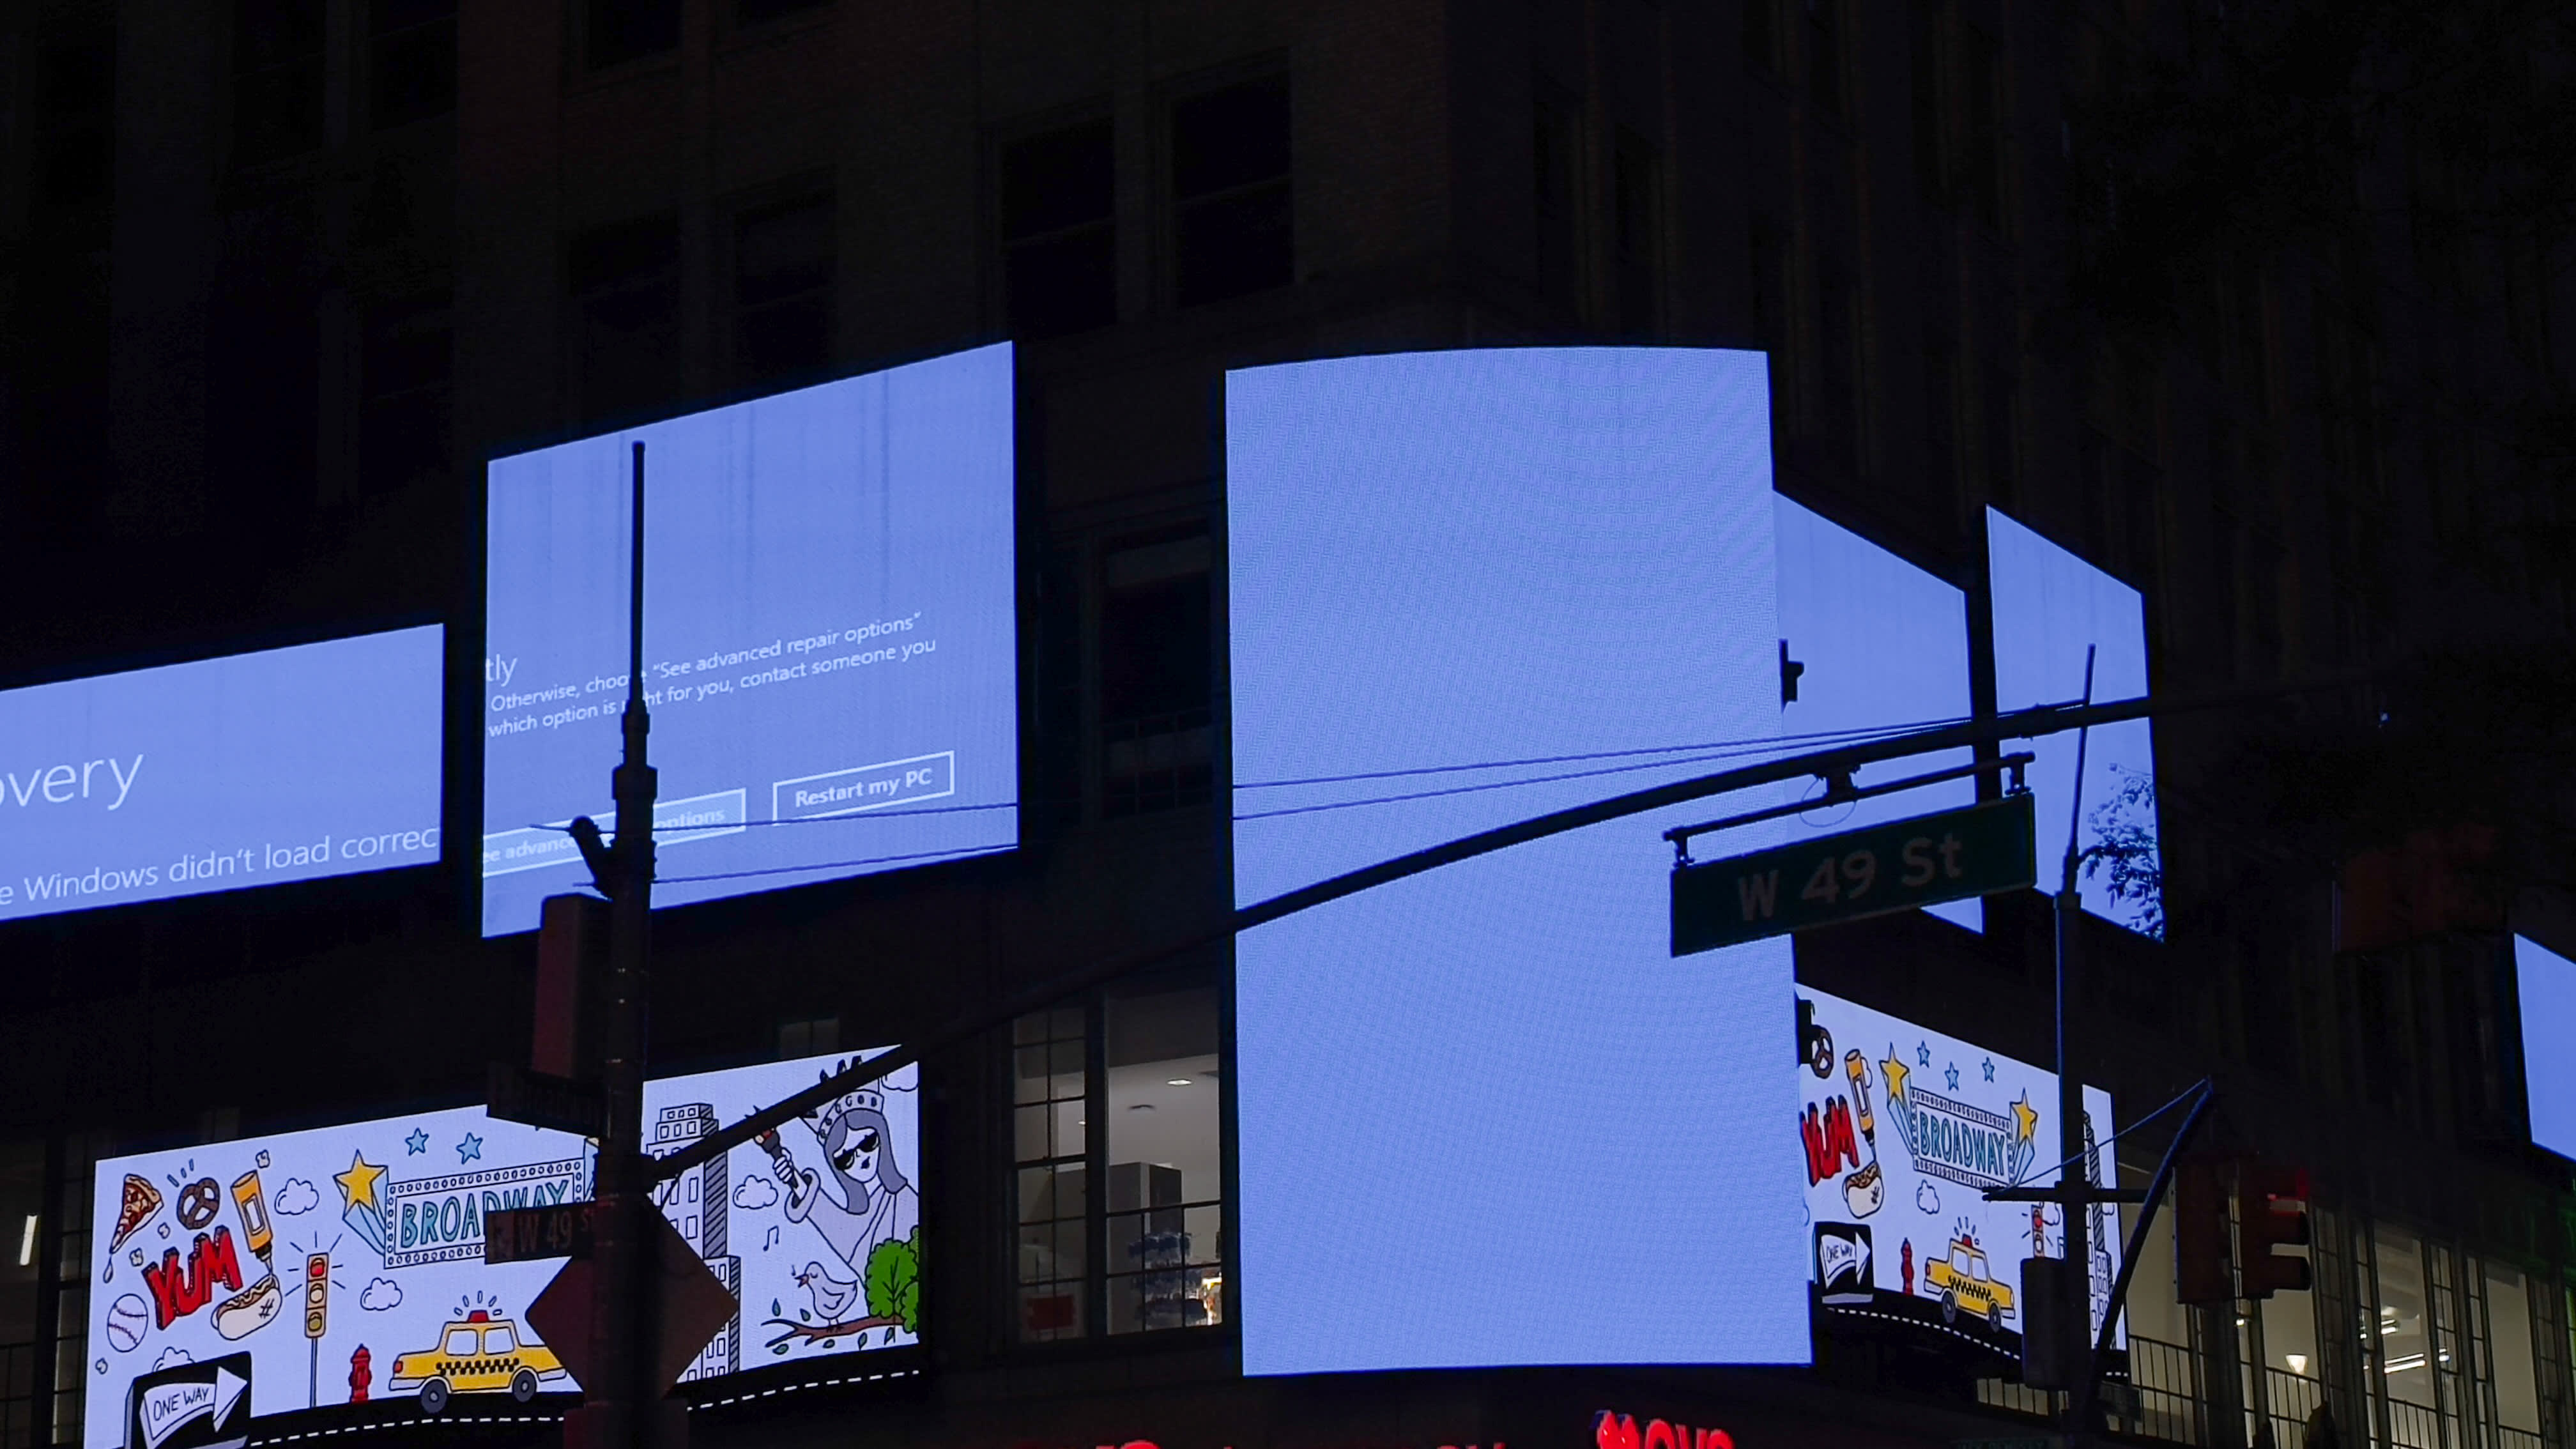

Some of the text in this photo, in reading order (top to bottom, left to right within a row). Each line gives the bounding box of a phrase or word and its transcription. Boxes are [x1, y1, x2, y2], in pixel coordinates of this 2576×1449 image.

[487, 715, 537, 737] which
[542, 705, 598, 729] option
[602, 699, 617, 715] is
[668, 686, 693, 702] for
[697, 678, 734, 702] you,
[740, 663, 807, 688] contact
[811, 647, 896, 674] someone
[901, 640, 937, 662] you
[491, 684, 581, 711] Otherwise,
[585, 671, 647, 693] choo
[696, 640, 781, 670] advanced
[786, 629, 840, 655] repair
[0, 754, 144, 810] very
[795, 768, 932, 808] Restart my PC
[23, 866, 159, 901] Windows
[169, 848, 254, 882] didn't
[265, 835, 330, 870] load
[341, 827, 439, 859] correc
[1738, 832, 1964, 922] W 49 St
[1799, 1094, 1860, 1188] YUM
[1919, 1110, 2005, 1177] BROADWAY
[515, 1213, 540, 1253] W
[546, 1210, 573, 1251] 49
[141, 1224, 243, 1331] YUM
[153, 1387, 210, 1422] ONE WAY
